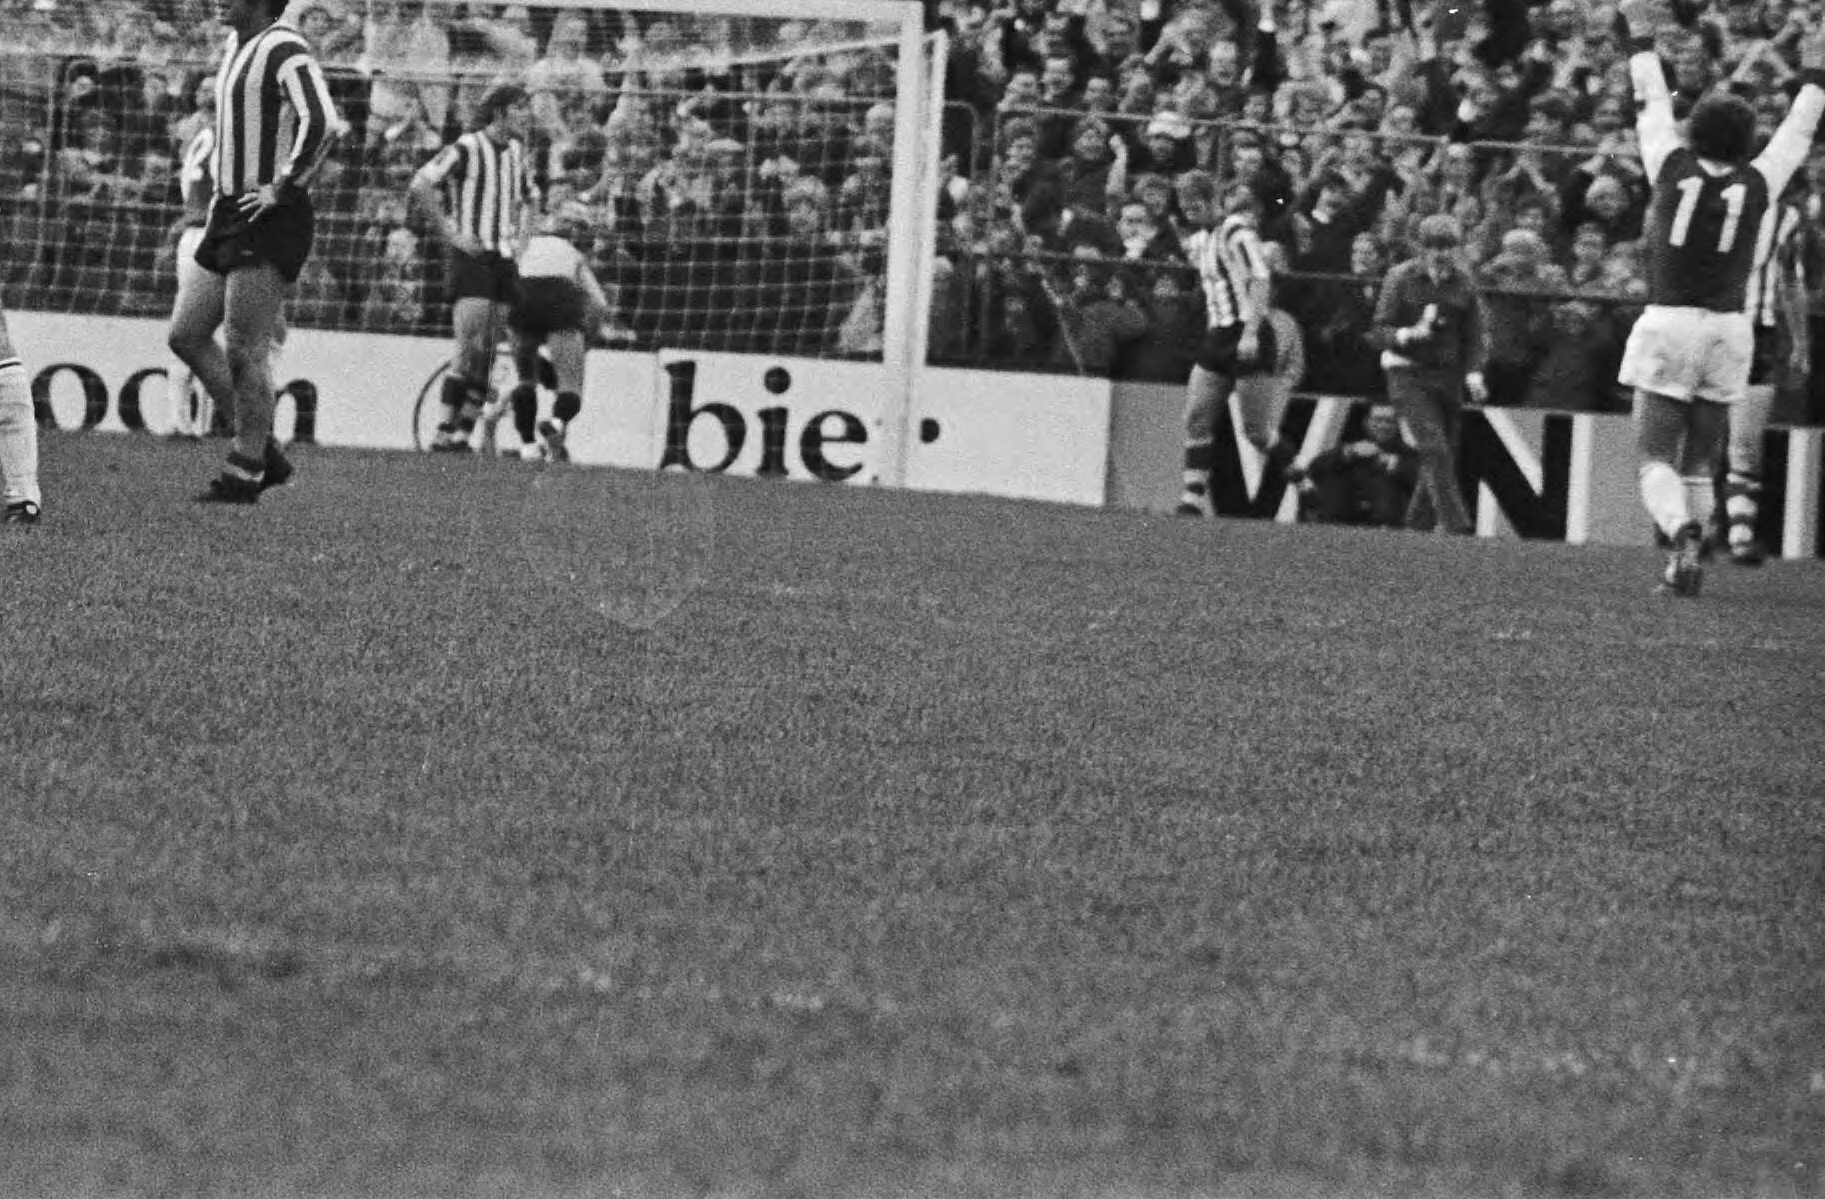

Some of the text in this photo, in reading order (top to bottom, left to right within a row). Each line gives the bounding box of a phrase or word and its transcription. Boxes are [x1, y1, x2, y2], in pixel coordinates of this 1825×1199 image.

[1668, 176, 1748, 253] 11
[661, 358, 941, 484] bie
[1183, 385, 1573, 542] VN
